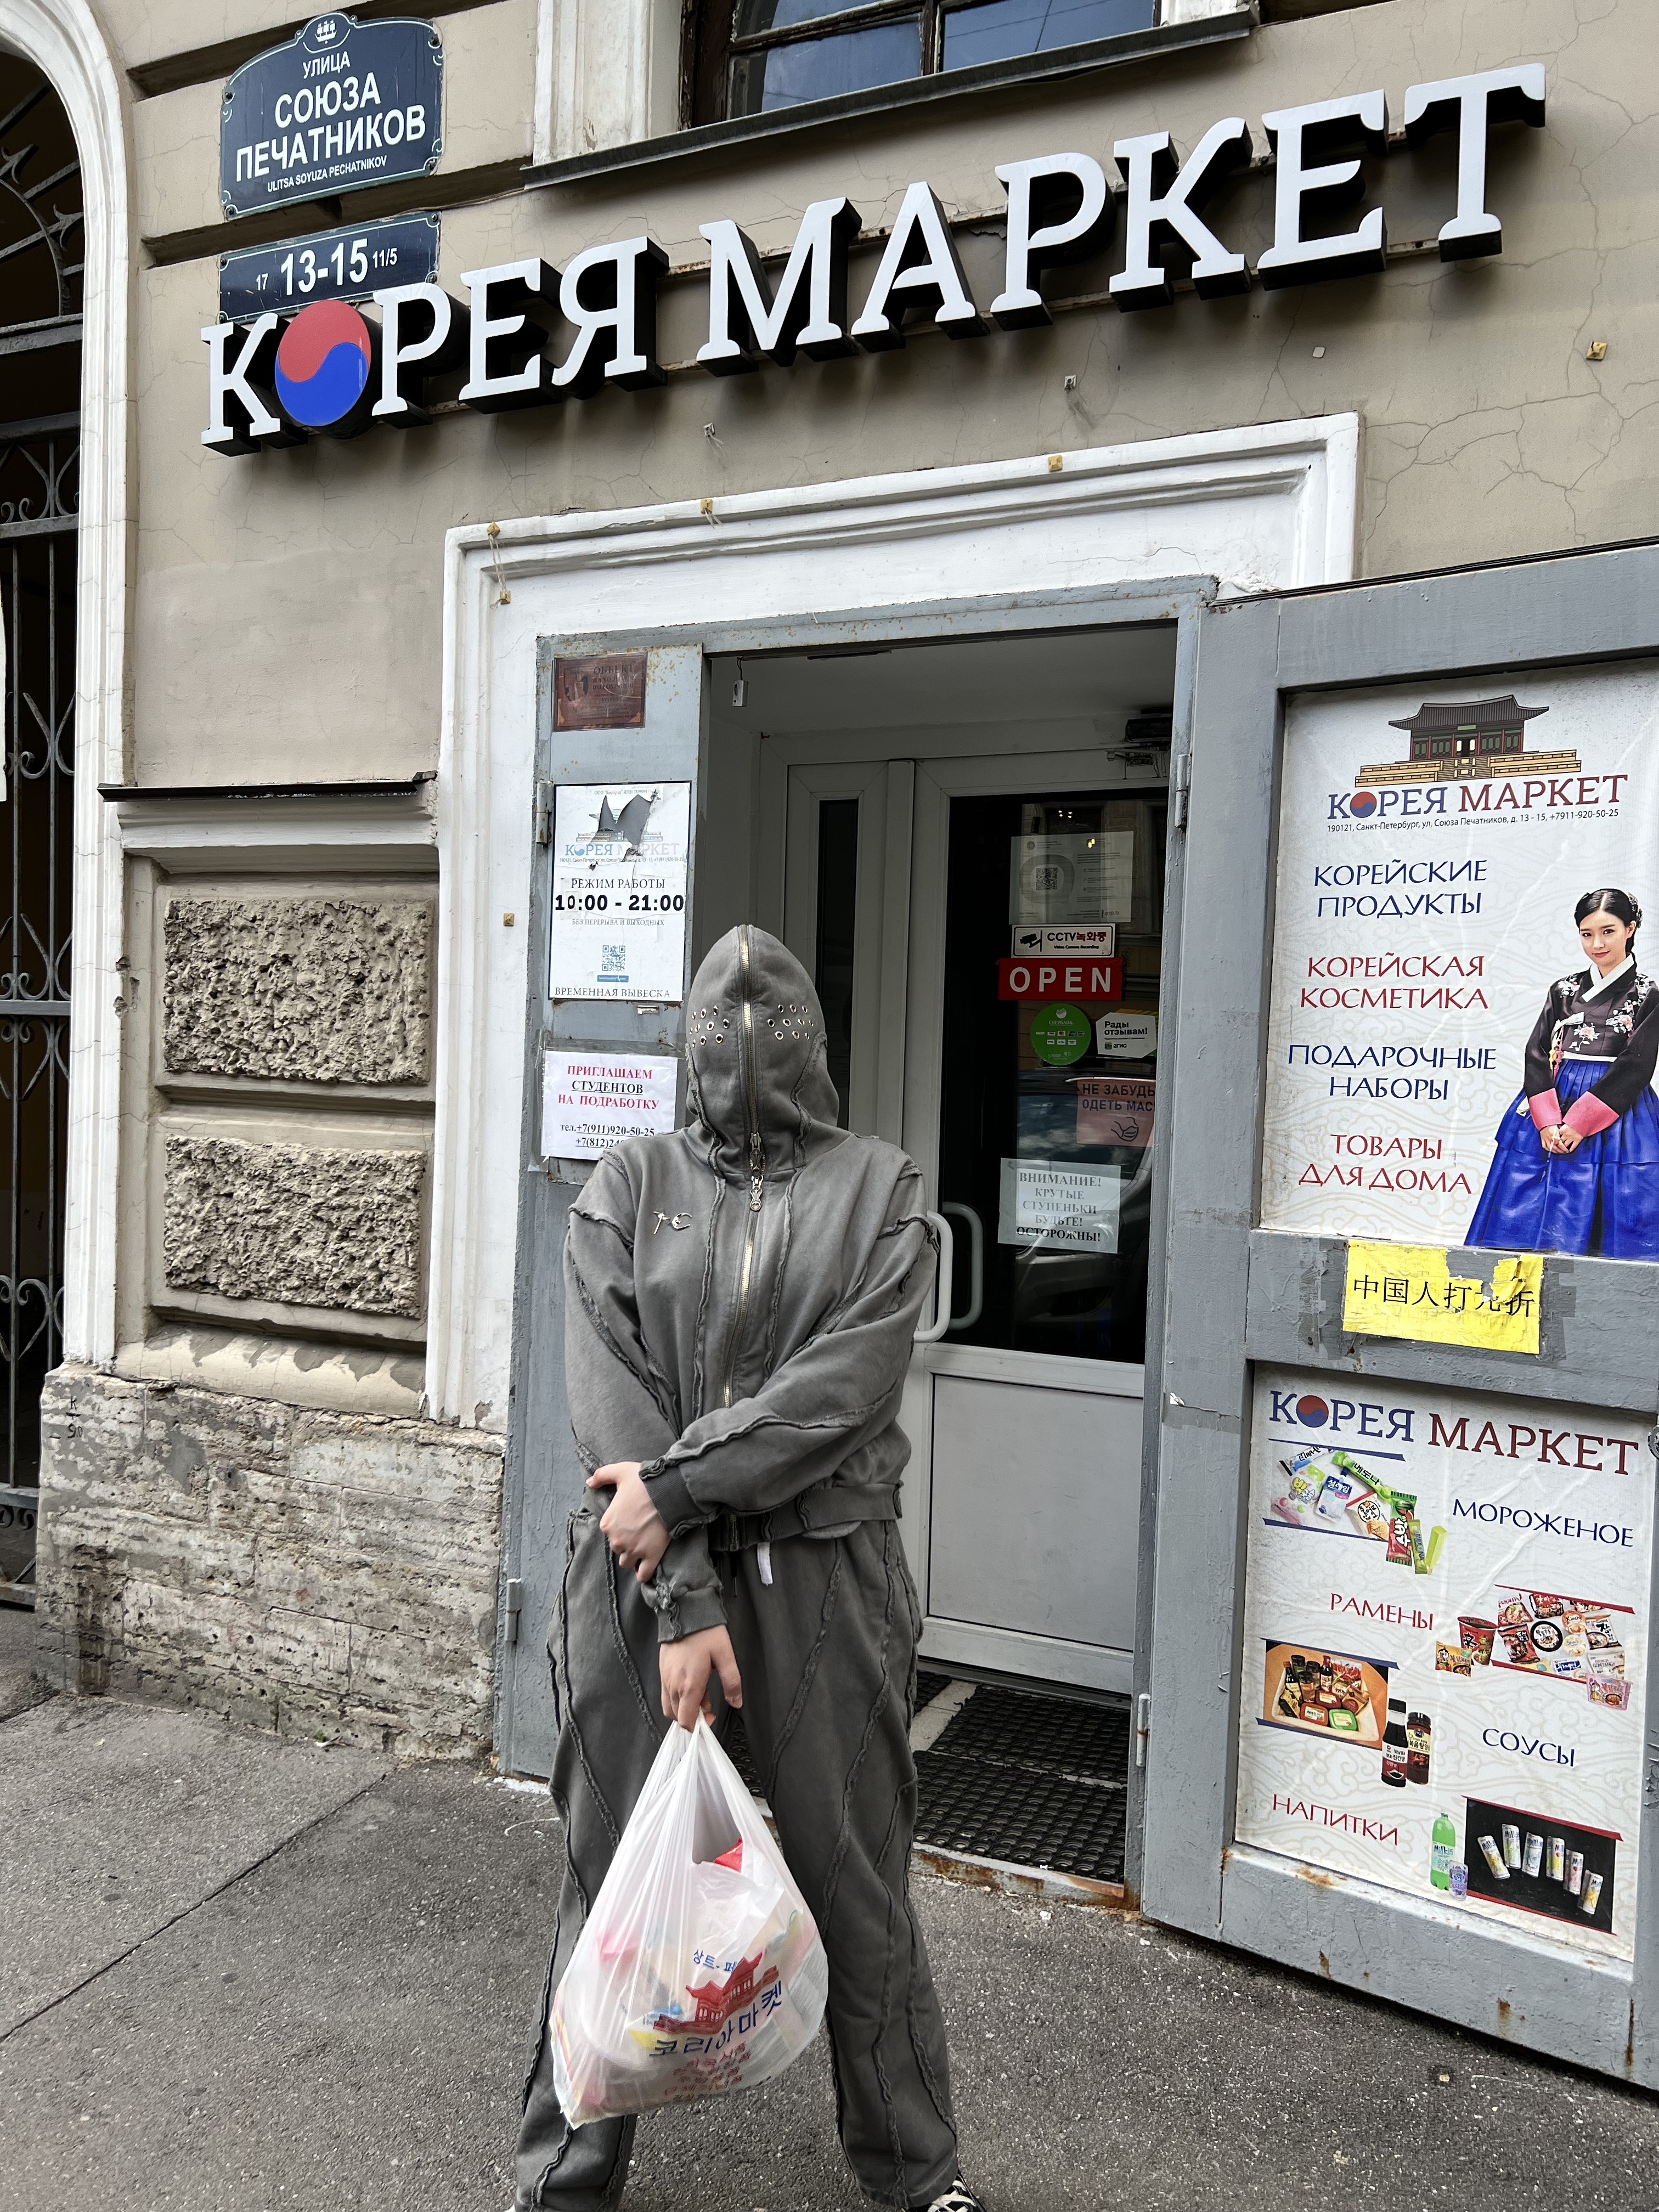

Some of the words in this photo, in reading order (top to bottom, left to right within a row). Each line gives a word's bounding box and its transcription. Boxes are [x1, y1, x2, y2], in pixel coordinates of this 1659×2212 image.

[303, 50, 351, 79] УЛИЦА
[275, 72, 381, 128] СОЮЗА
[236, 104, 426, 182] ПЕЧАТНИКОВ
[267, 174, 295, 192] ULITSA
[295, 166, 328, 185] SOYUZA
[329, 155, 387, 178] PECHATNIKOV
[201, 236, 648, 445] КОРЕЯ
[696, 63, 1545, 370] МАРКЕТ
[256, 273, 268, 291] 17
[281, 238, 369, 296] 13-15
[372, 248, 398, 269] 11/5
[1327, 787, 1448, 820] КОРЕЯ
[1458, 774, 1628, 812] МАРКЕТ
[1356, 821, 1420, 831] Санкт-Петербург,
[1434, 819, 1459, 827] Союза
[1460, 816, 1509, 826] Печатников,
[1510, 816, 1518, 824] д.
[1520, 814, 1529, 822] 13
[1536, 813, 1548, 821] 15,
[1549, 809, 1619, 821] +7911-920-50-25
[565, 844, 613, 856] КОРЕЯ
[571, 879, 614, 889] РЕЖИМ
[617, 878, 665, 889] РАБОТЫ
[1314, 859, 1487, 887] КОРЕЙСКИЕ
[555, 894, 608, 911] 10:00
[629, 894, 684, 911] 21:00
[1317, 893, 1482, 918] ПРОДУКТЫ
[1307, 952, 1485, 978] КОРЕЙСКАЯ
[1009, 967, 1111, 992] OPEN
[555, 987, 618, 997] ВРЕМЕННАЯ
[621, 988, 670, 998] ВЫВЕСКА
[1300, 988, 1488, 1009] КОСМЕТИКА
[1104, 1021, 1129, 1029] Рады
[1104, 1027, 1148, 1035] отзывам!
[1288, 1045, 1497, 1069] ПОДАРОЧНЫЕ
[567, 1065, 653, 1080] ПРИГЛАШАЕМ
[572, 1080, 644, 1094] СТУДЕНТОВ
[1082, 1084, 1099, 1095] НЕ
[1103, 1084, 1155, 1098] ЗАБУДЬ
[1329, 1076, 1449, 1101] НАБОРЫ
[558, 1094, 574, 1104] НА
[579, 1095, 660, 1110] ПОДРАБОТКУ
[1082, 1099, 1122, 1111] ОДЕТЬ
[575, 1137, 624, 1148] +7(812)24
[1330, 1134, 1442, 1160] ТОВАРЫ
[1019, 1172, 1102, 1187] ВНИМАНИЕ!
[1299, 1163, 1363, 1187] ДЛЯ
[1368, 1167, 1472, 1194] ДОМА
[1035, 1188, 1085, 1200] КРУТЫЕ
[1022, 1200, 1098, 1215] СТУПЕНЬКИ
[1035, 1215, 1083, 1227] БУДЬТЕ!
[1016, 1226, 1101, 1242] ОСТОРОЖНЫ!
[1269, 1390, 1415, 1442] КОРЕЯ
[1427, 1413, 1639, 1475] МАРКЕТ
[1327, 1479, 1350, 1494] 설레임
[1453, 1498, 1634, 1548] МОРОЖЕНОЕ
[1330, 1592, 1434, 1630] РАМЕНЫ
[1482, 1728, 1576, 1767] СОУСЫ
[1272, 1794, 1398, 1846] НАПИТКИ
[1434, 1844, 1453, 1855] Milkis
[648, 1980, 782, 2057] 코리아마켓
